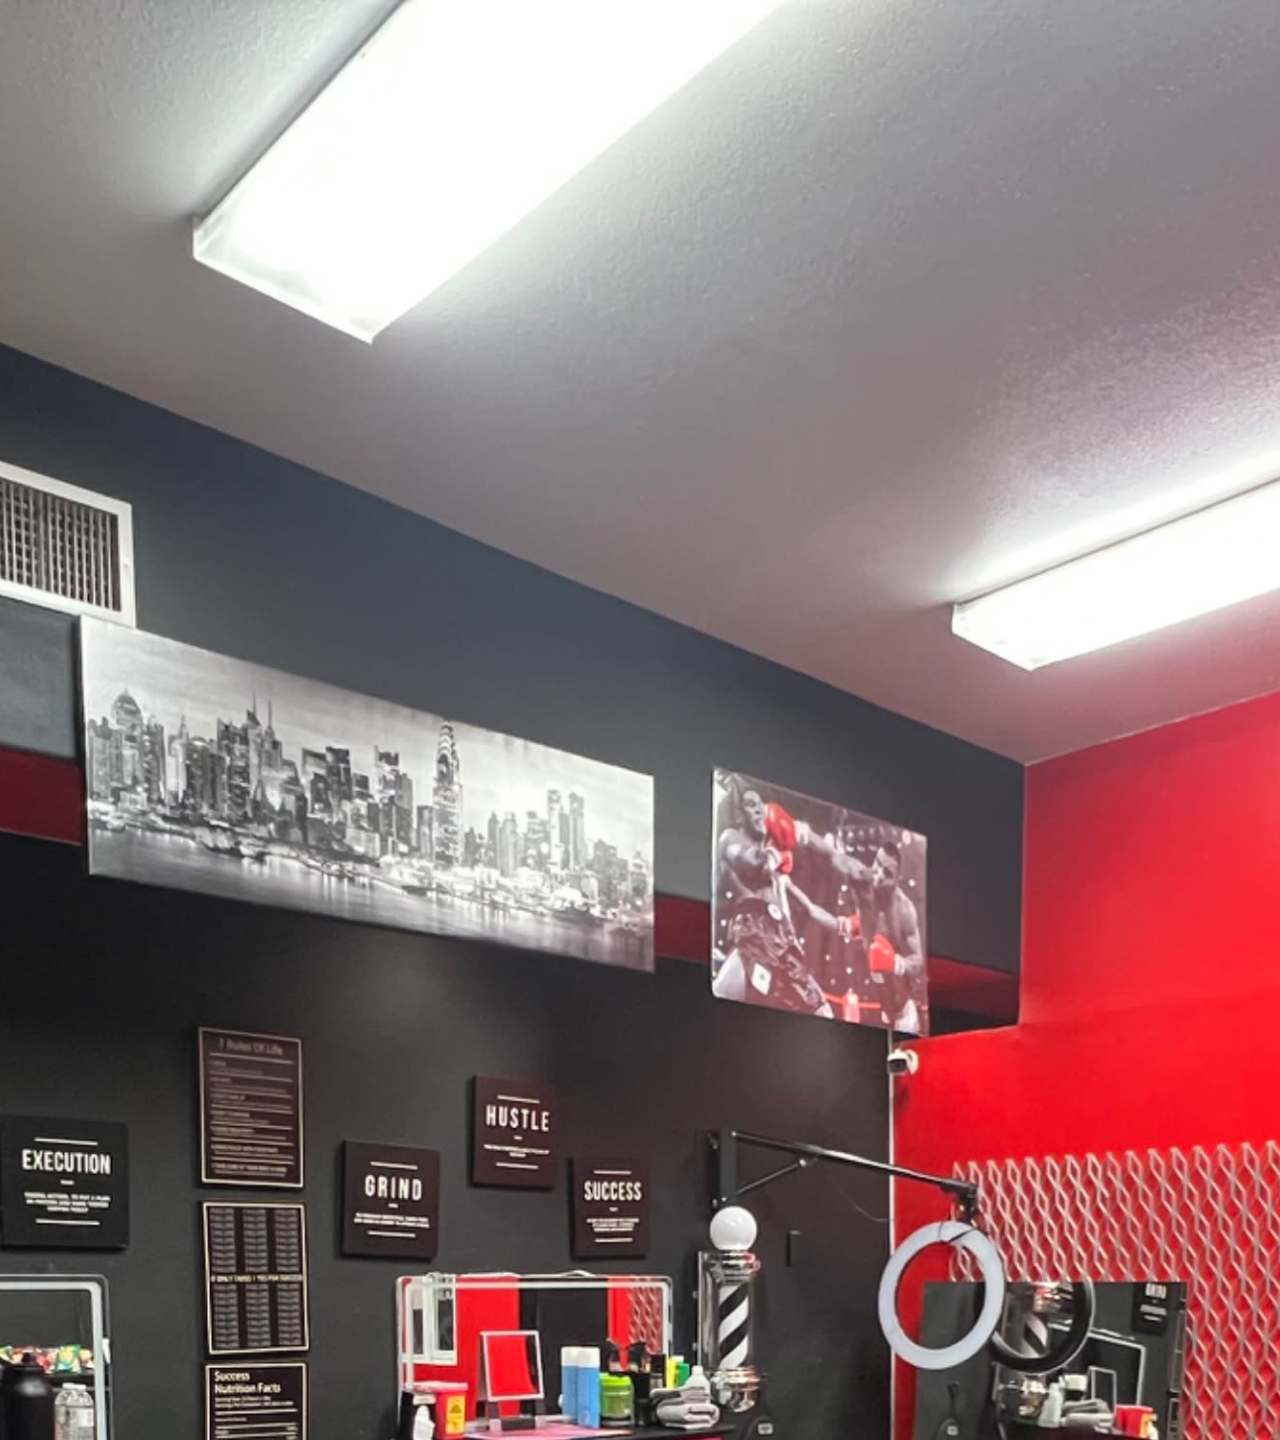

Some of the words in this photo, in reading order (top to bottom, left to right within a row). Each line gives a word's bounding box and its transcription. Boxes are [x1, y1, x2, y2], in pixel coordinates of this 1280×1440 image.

[485, 1104, 550, 1131] HUSTLE
[22, 1149, 111, 1175] EXECUTION
[365, 1174, 422, 1200] GRIND
[583, 1180, 642, 1201] SUCCESS
[214, 1371, 250, 1382] Success
[214, 1383, 256, 1394] Nutrition
[258, 1382, 281, 1393] Facts
